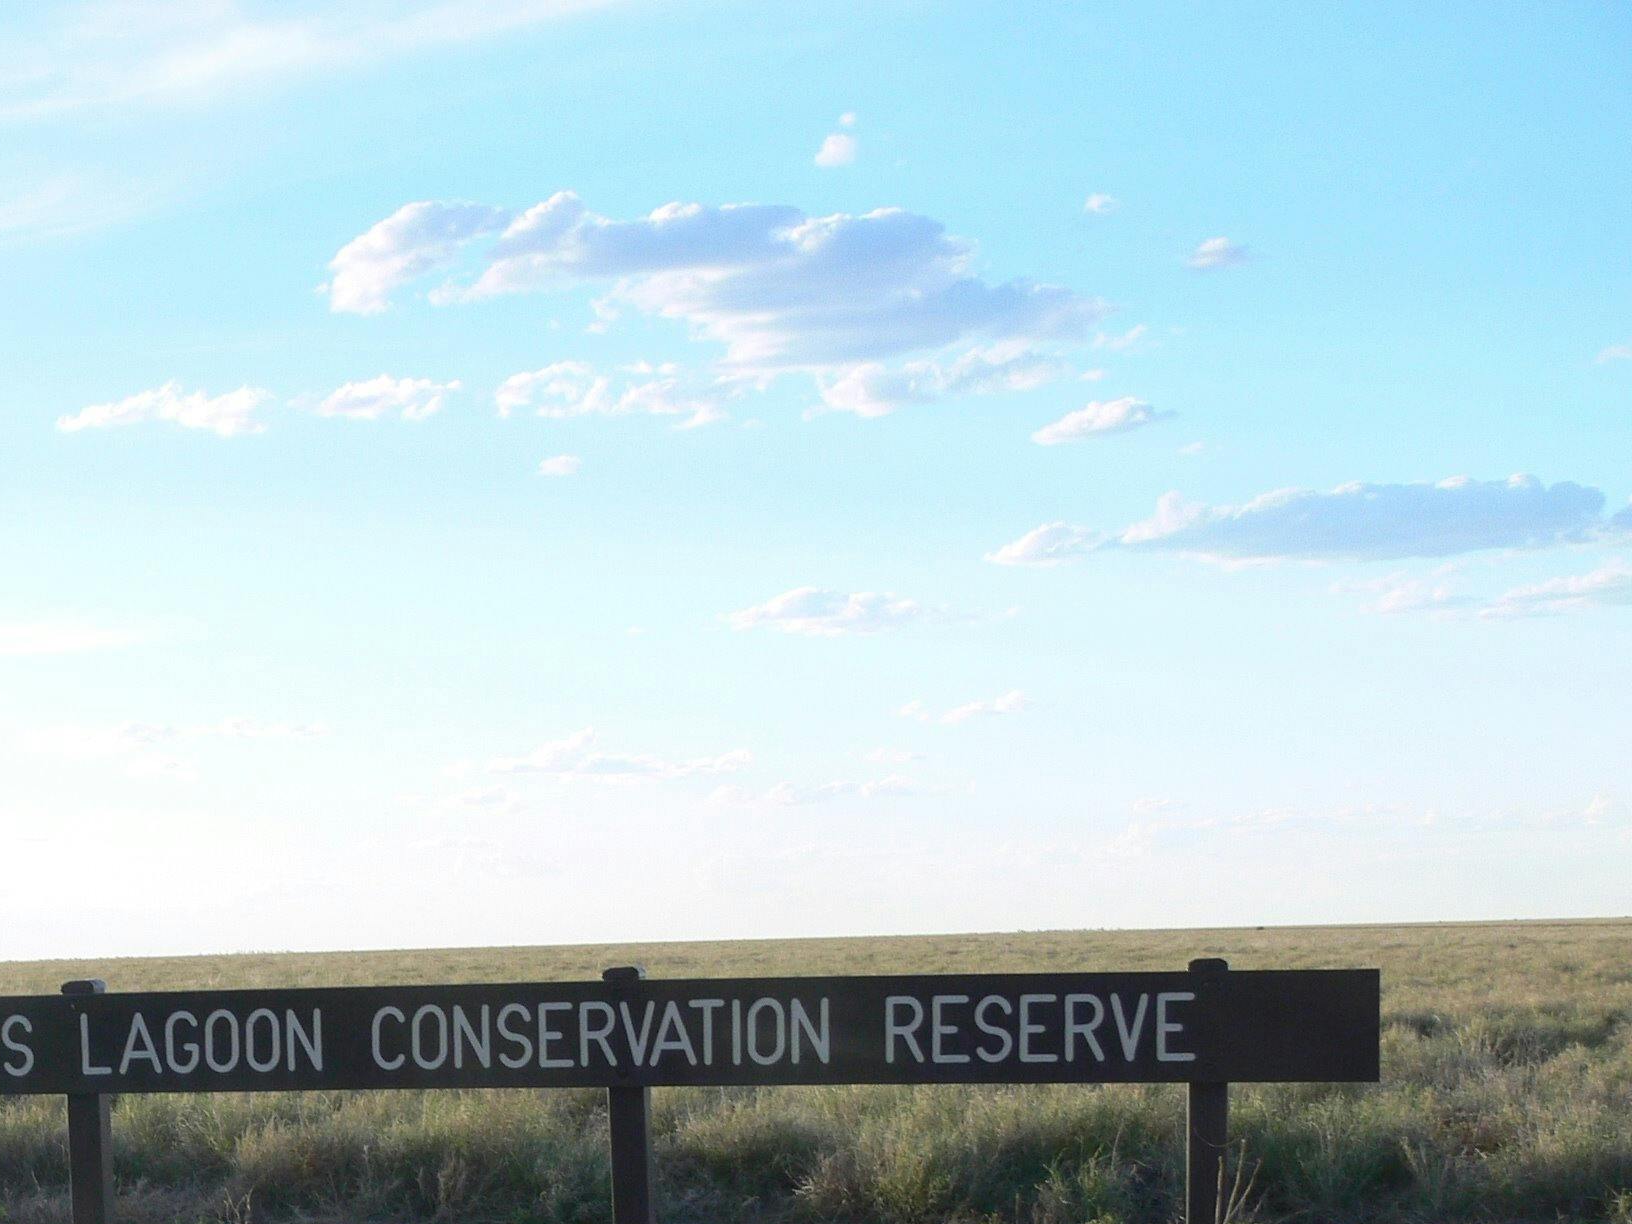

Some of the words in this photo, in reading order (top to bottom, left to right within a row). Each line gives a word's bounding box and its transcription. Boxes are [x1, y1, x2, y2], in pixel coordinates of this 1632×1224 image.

[79, 1008, 324, 1076] LAGOON
[370, 996, 831, 1071] CONSERVATION
[884, 991, 1197, 1065] RESERVE
